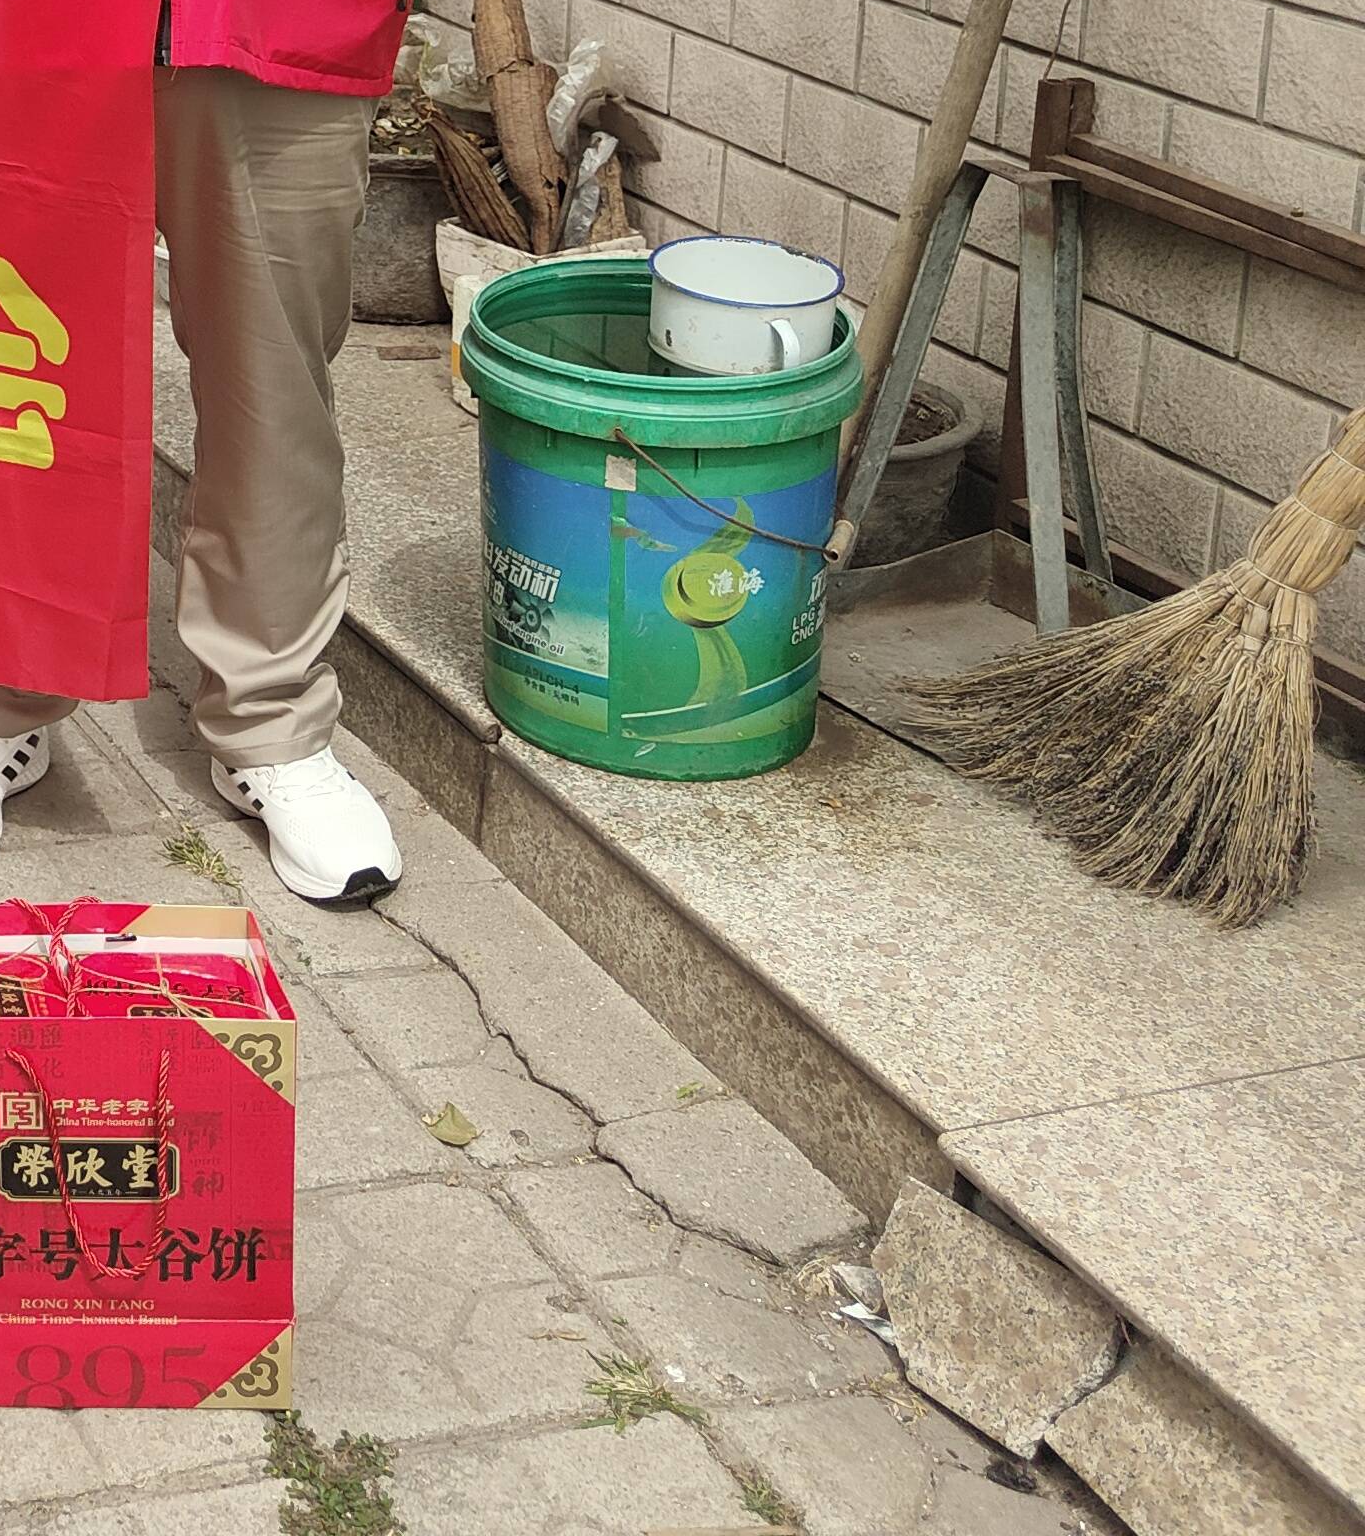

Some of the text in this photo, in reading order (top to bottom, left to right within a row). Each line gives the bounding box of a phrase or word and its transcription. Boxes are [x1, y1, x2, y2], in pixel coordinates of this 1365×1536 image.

[793, 607, 815, 631] LPG
[517, 629, 548, 650] engine
[549, 644, 566, 656] oil
[791, 623, 815, 645] CNG
[21, 1298, 155, 1310] RONG XIN TANG
